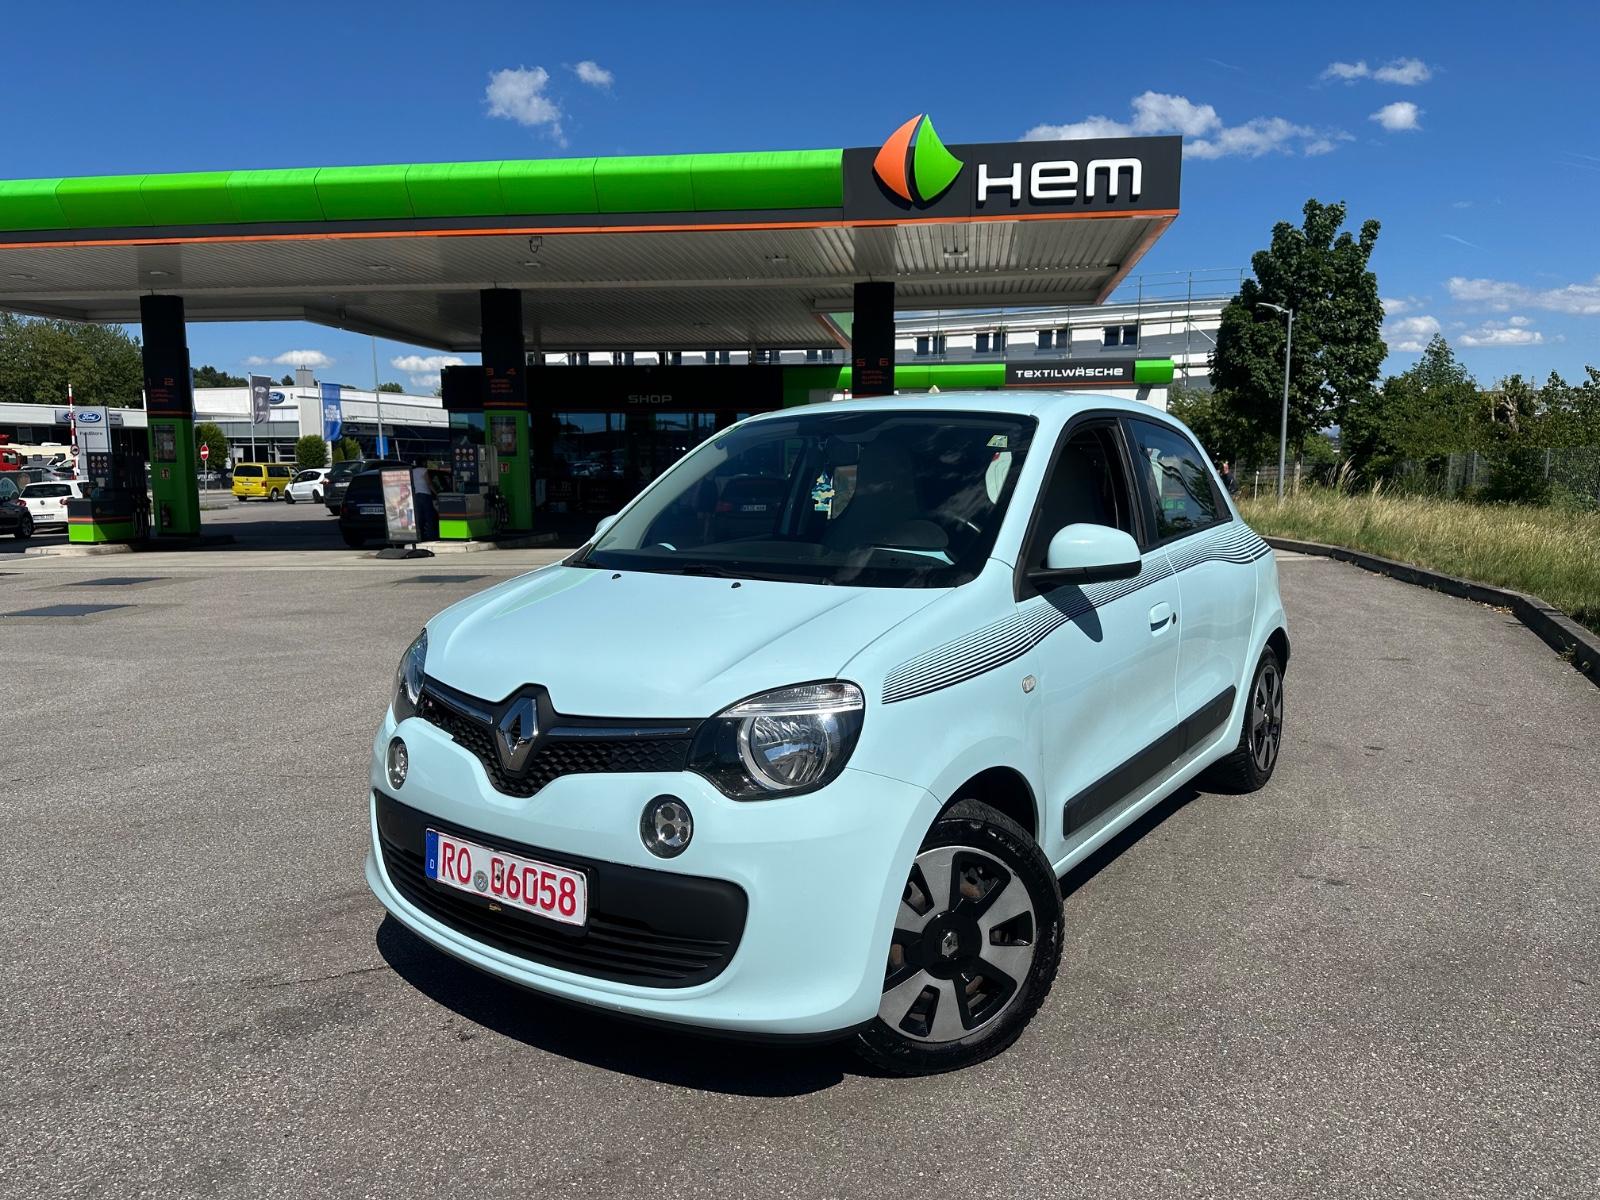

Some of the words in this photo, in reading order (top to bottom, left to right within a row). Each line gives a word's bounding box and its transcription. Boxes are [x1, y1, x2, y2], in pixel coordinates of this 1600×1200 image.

[627, 394, 673, 404] SHOP
[81, 413, 100, 421] Ford
[441, 841, 472, 885] RO
[490, 857, 577, 917] 06058
